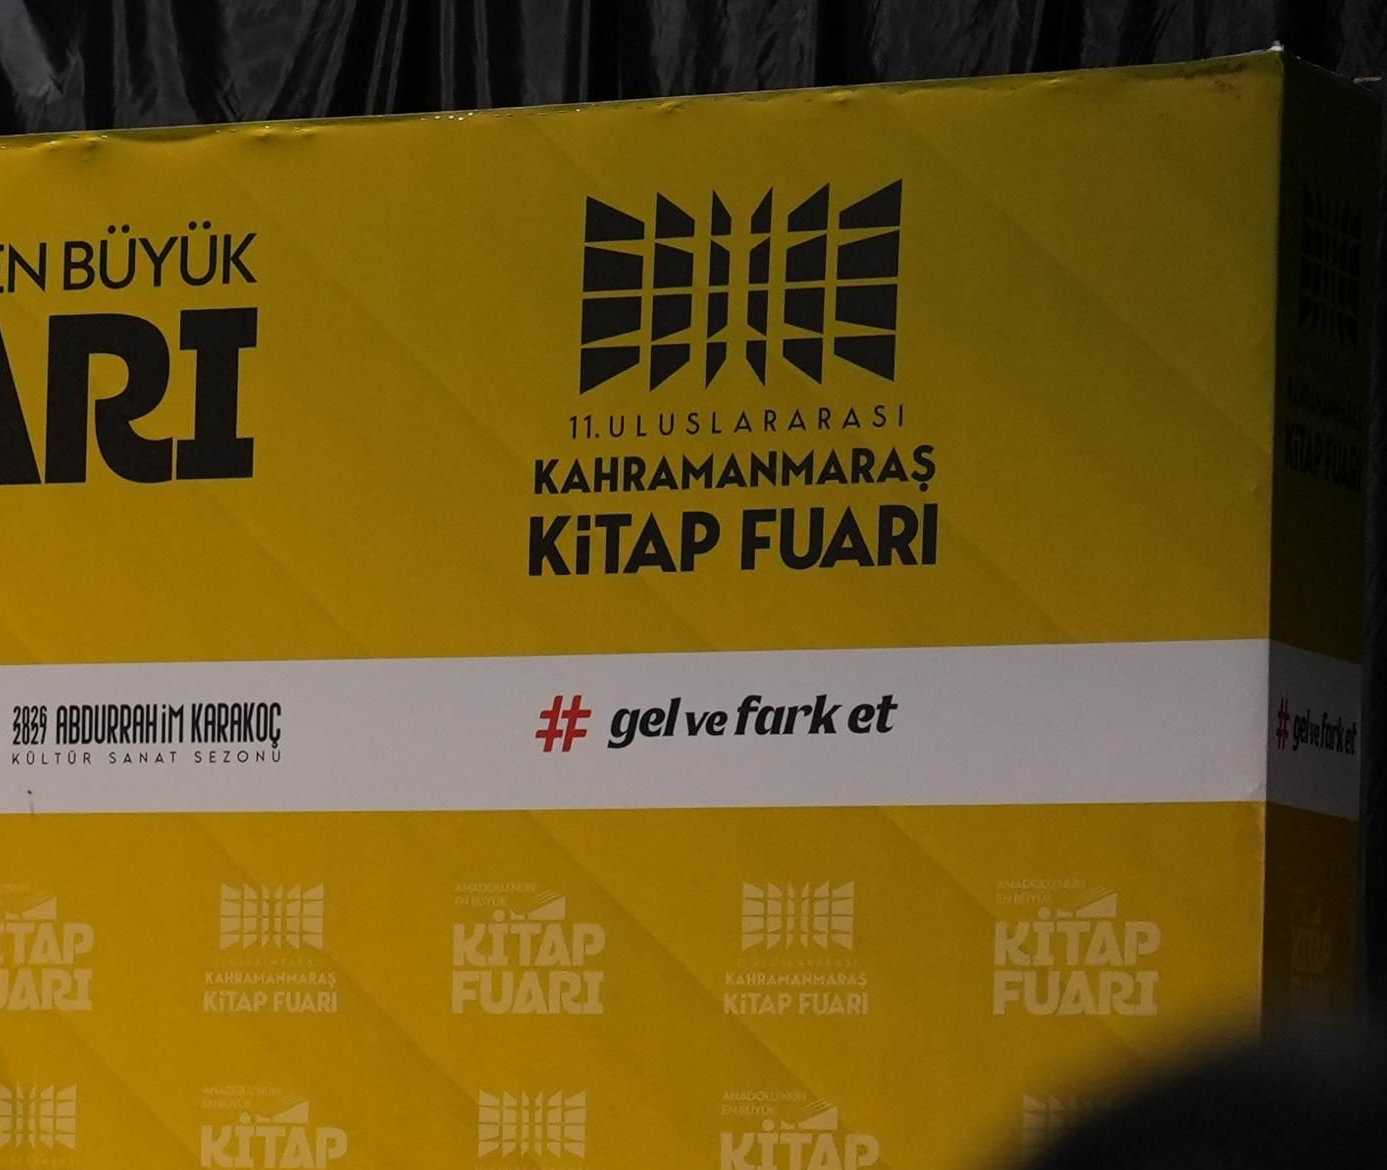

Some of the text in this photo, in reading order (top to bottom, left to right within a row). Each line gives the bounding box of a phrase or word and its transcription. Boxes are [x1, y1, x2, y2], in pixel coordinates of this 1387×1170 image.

[61, 220, 259, 292] BÜYÜK
[533, 444, 937, 495] KAHRAMANMARAŞ
[739, 502, 939, 570] FUARI
[190, 701, 282, 750] KARAKOÇ
[607, 697, 682, 749] gel
[684, 710, 729, 737] ve
[734, 693, 843, 736] fark
[846, 694, 899, 734] et
[108, 750, 178, 764] SANAT
[193, 749, 282, 763] SEZONU
[452, 909, 606, 966] KİTAP
[993, 906, 1163, 966] KİTAP
[273, 988, 338, 1014] FUARI
[451, 969, 606, 1015] FUARI
[798, 991, 869, 1017] FUARI
[992, 969, 1160, 1017] FUARI
